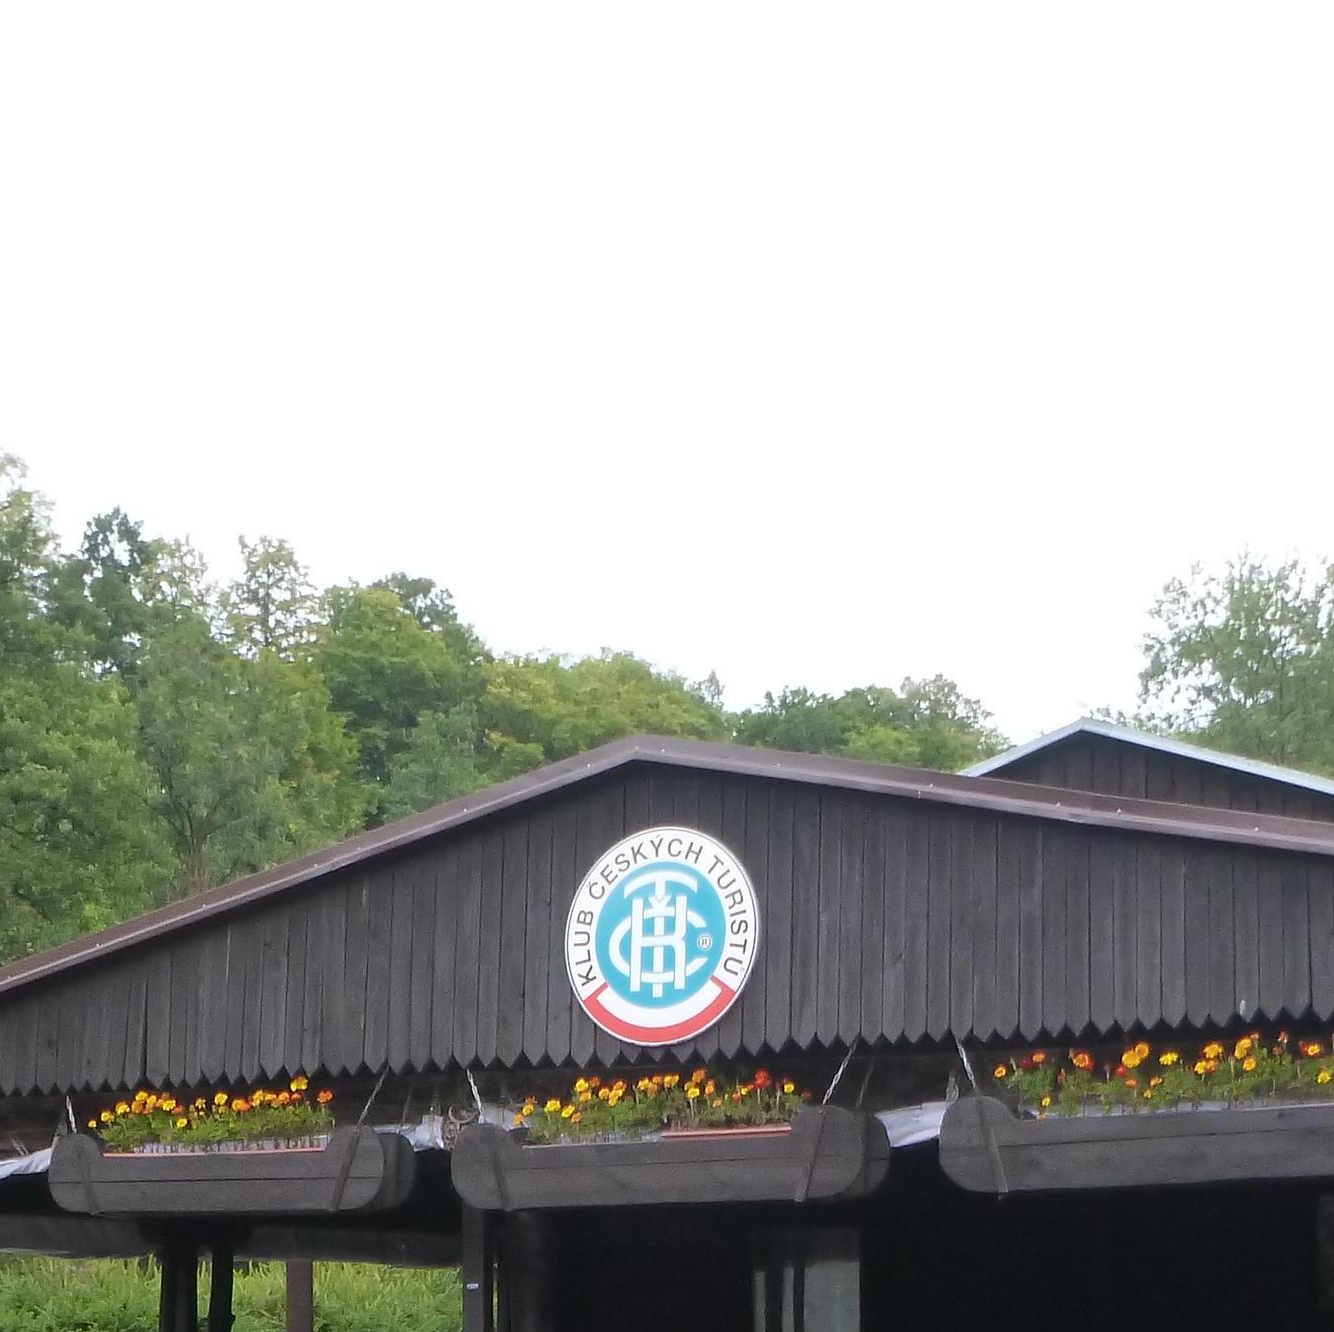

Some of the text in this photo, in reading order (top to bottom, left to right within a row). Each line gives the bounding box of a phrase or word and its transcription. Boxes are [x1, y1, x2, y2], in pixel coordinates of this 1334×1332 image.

[574, 834, 749, 987] KLUB ČESKÝCH TURISTŮ
